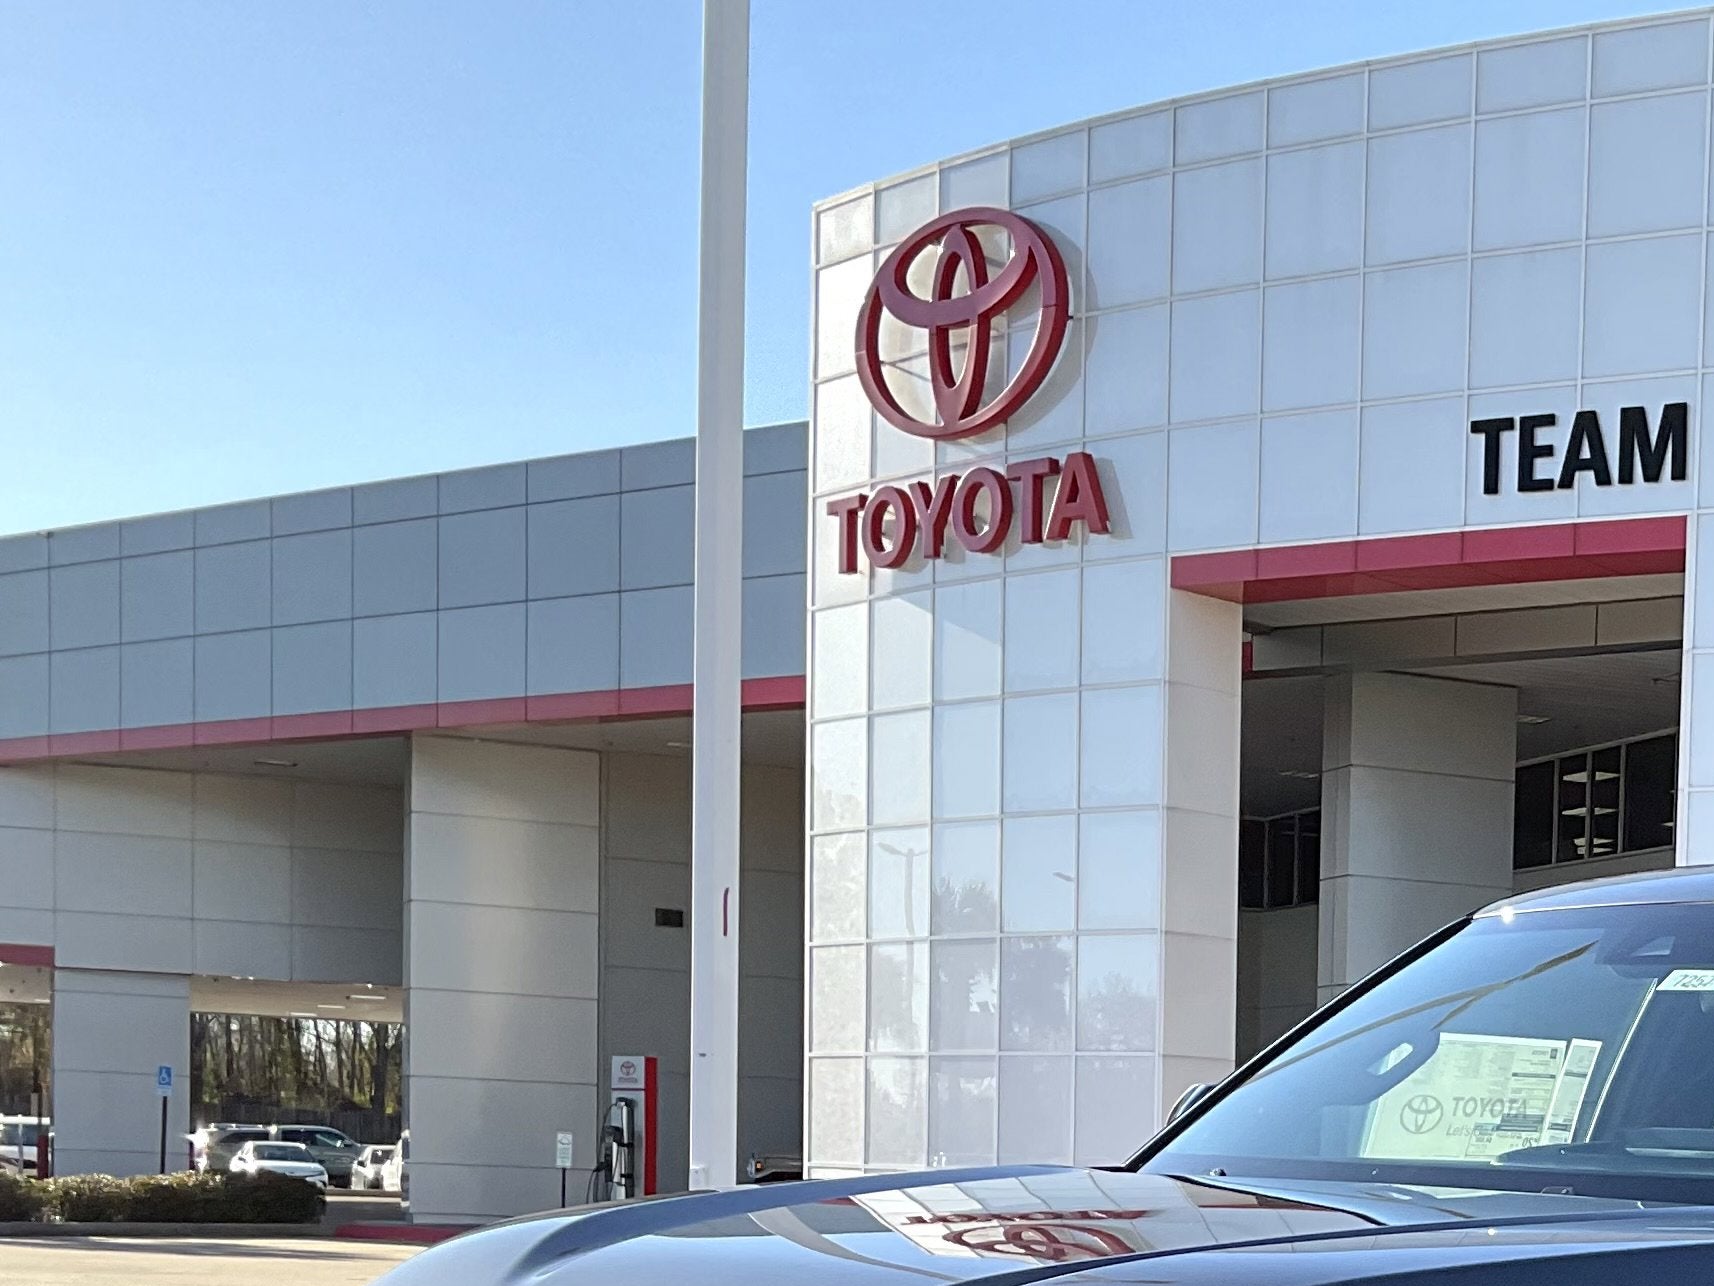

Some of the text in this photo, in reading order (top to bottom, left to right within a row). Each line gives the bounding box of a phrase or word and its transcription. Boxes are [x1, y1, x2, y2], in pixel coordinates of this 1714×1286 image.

[1470, 402, 1687, 495] TEAM
[827, 452, 1110, 574] TOYOTA
[1452, 1096, 1527, 1119] TOYOTA
